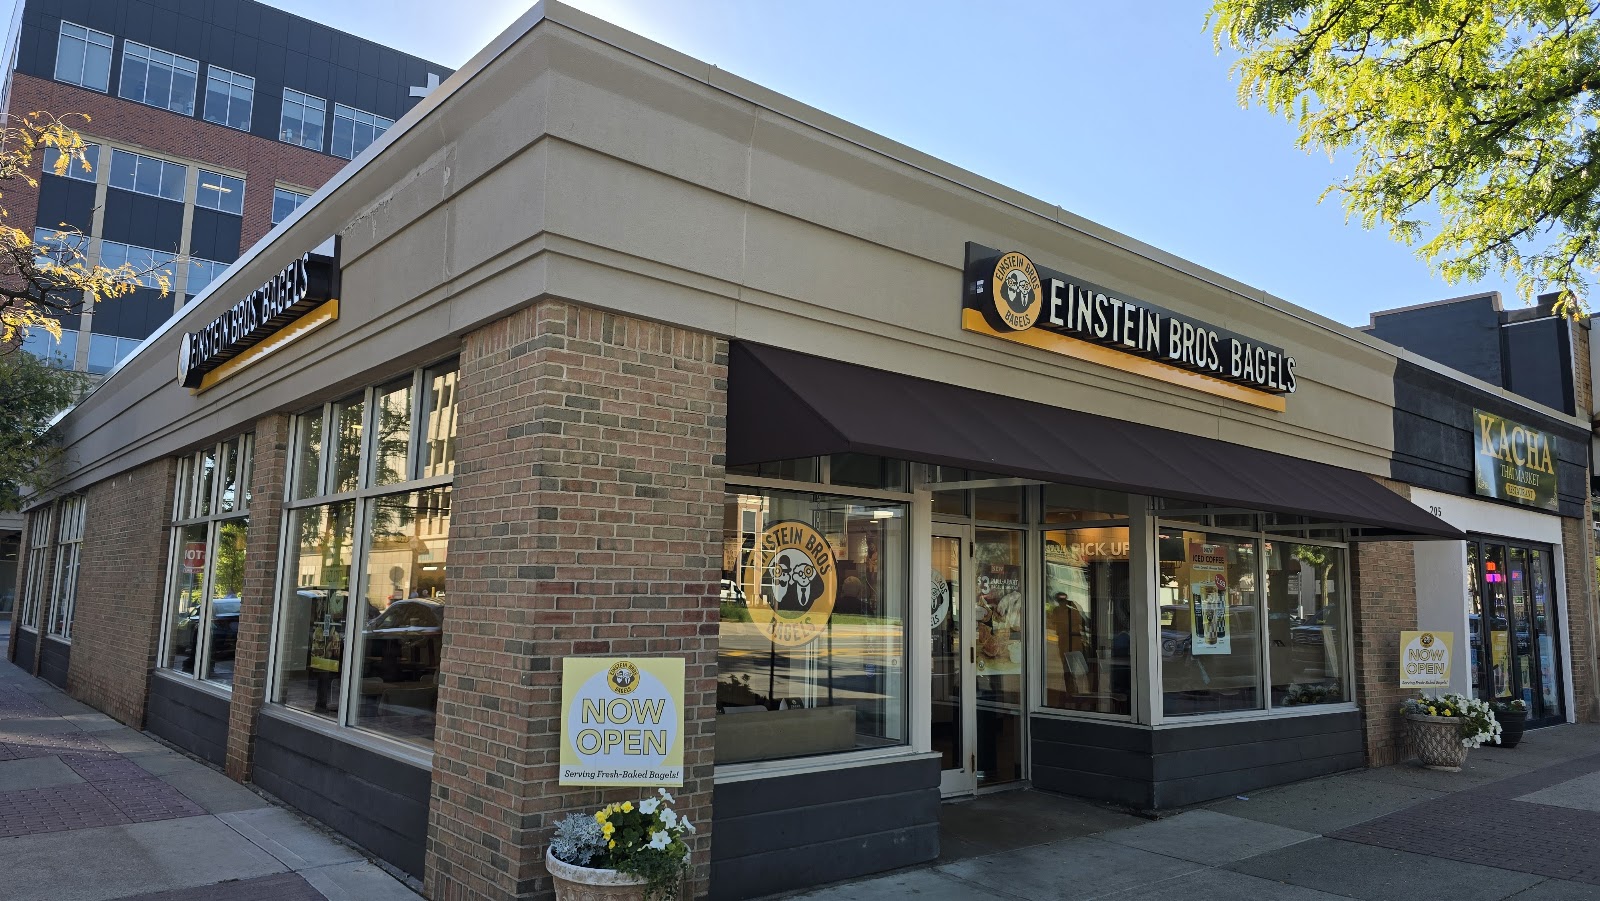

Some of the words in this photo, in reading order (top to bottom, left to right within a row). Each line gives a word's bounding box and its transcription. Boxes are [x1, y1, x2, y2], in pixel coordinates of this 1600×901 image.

[996, 256, 1024, 281] EINSTEIN
[1025, 263, 1040, 290] BROS
[190, 311, 229, 369] EINSTEIN
[262, 252, 309, 325] BAGELS
[1005, 310, 1031, 328] BAGELS
[1050, 278, 1162, 355] EINSTEIN
[1169, 317, 1224, 372] BROS.
[1231, 338, 1297, 394] BAGELS
[1479, 414, 1555, 475] KACHA
[1501, 464, 1514, 480] THAI
[1515, 469, 1540, 487] MARKET
[1429, 505, 1442, 517] 205
[750, 527, 803, 567] NSTEIN
[805, 535, 832, 576] BROS
[1071, 542, 1107, 556] PICK
[1193, 555, 1204, 563] ICED
[1206, 556, 1224, 564] COFFEE
[977, 575, 990, 594] $3
[1408, 649, 1444, 661] NOW
[1406, 663, 1444, 674] OPEN
[582, 698, 666, 724] NOW
[576, 729, 667, 755] OPEN
[564, 770, 595, 779] Serving
[597, 770, 648, 778] Fresh-Baked
[649, 771, 680, 780] Bagels!
